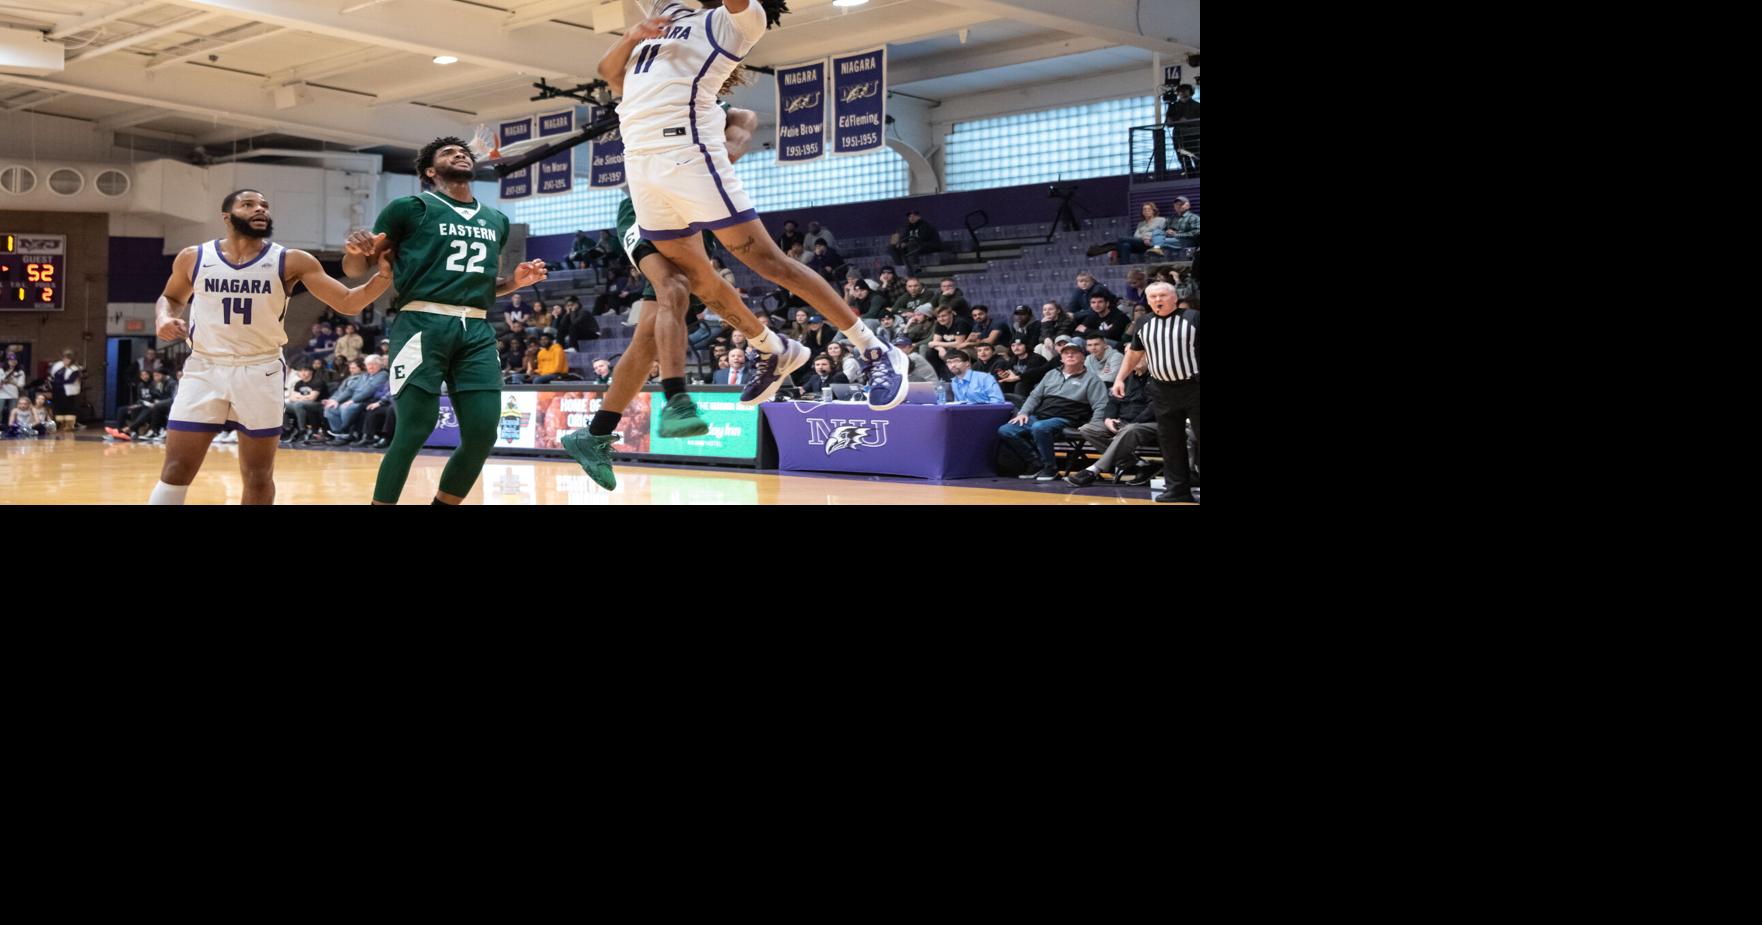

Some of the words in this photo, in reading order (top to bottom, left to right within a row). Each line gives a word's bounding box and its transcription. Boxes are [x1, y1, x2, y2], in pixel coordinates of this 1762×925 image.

[634, 44, 661, 74] 11
[840, 57, 876, 75] NIAGARA
[784, 69, 817, 86] NIAGARA
[439, 223, 496, 242] EASTERN
[22, 255, 53, 263] GUEST
[445, 239, 487, 274] 22
[26, 263, 54, 282] 52
[41, 287, 53, 302] 2
[204, 278, 272, 294] NIAGARA
[221, 297, 253, 325] 14
[510, 311, 523, 321] N
[394, 365, 406, 379] E
